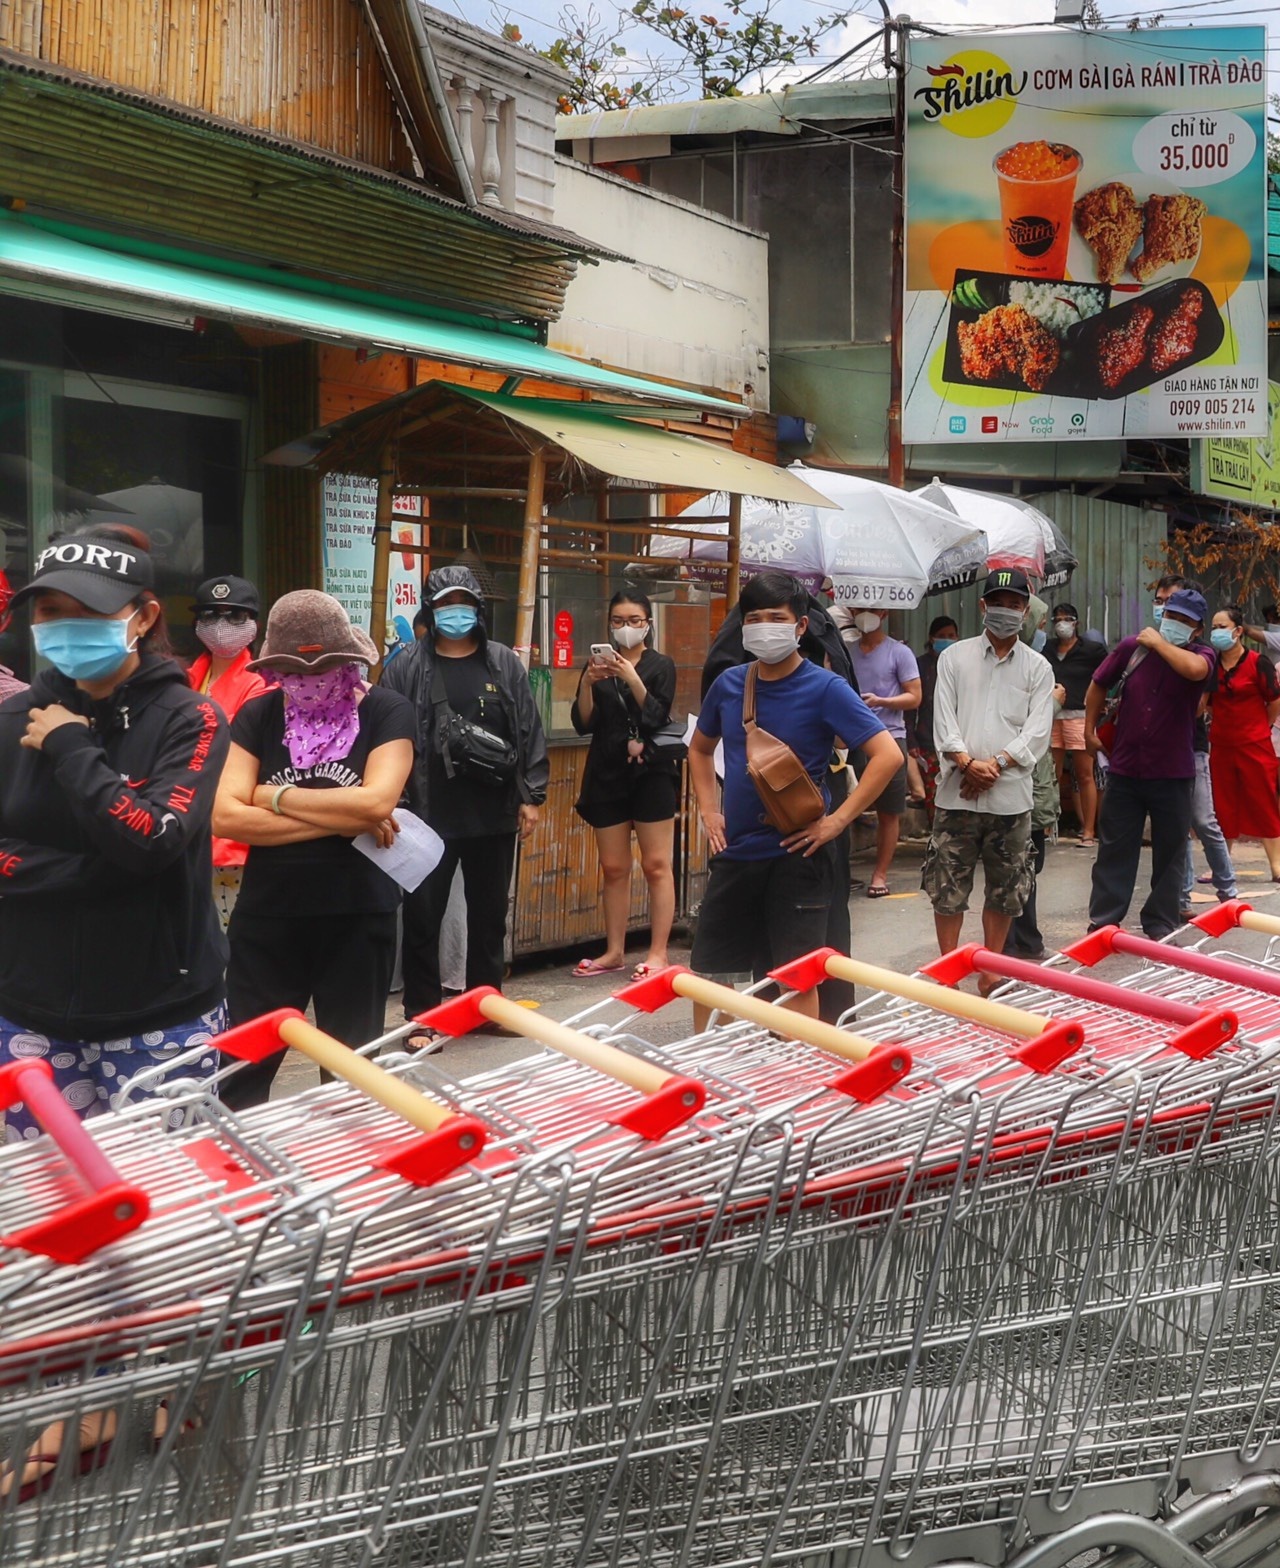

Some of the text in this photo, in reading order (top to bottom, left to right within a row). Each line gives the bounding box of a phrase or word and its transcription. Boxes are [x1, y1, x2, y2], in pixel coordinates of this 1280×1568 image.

[1034, 58, 1263, 90] CƠM GÀ GÀ RÁN TRÀ ĐÀO
[914, 69, 1028, 118] Shilin
[1171, 117, 1217, 137] chỉ từ
[1164, 376, 1259, 393] GIAO HÀNG TẬN NƠI
[1170, 398, 1255, 416] 0909 005 214
[1001, 421, 1020, 429] Now
[1029, 416, 1054, 425] Grab
[1177, 418, 1246, 431] www.shilin.vn
[1031, 426, 1053, 434] Food
[34, 544, 136, 576] PORT
[863, 586, 885, 600] 817
[889, 587, 915, 600] 566
